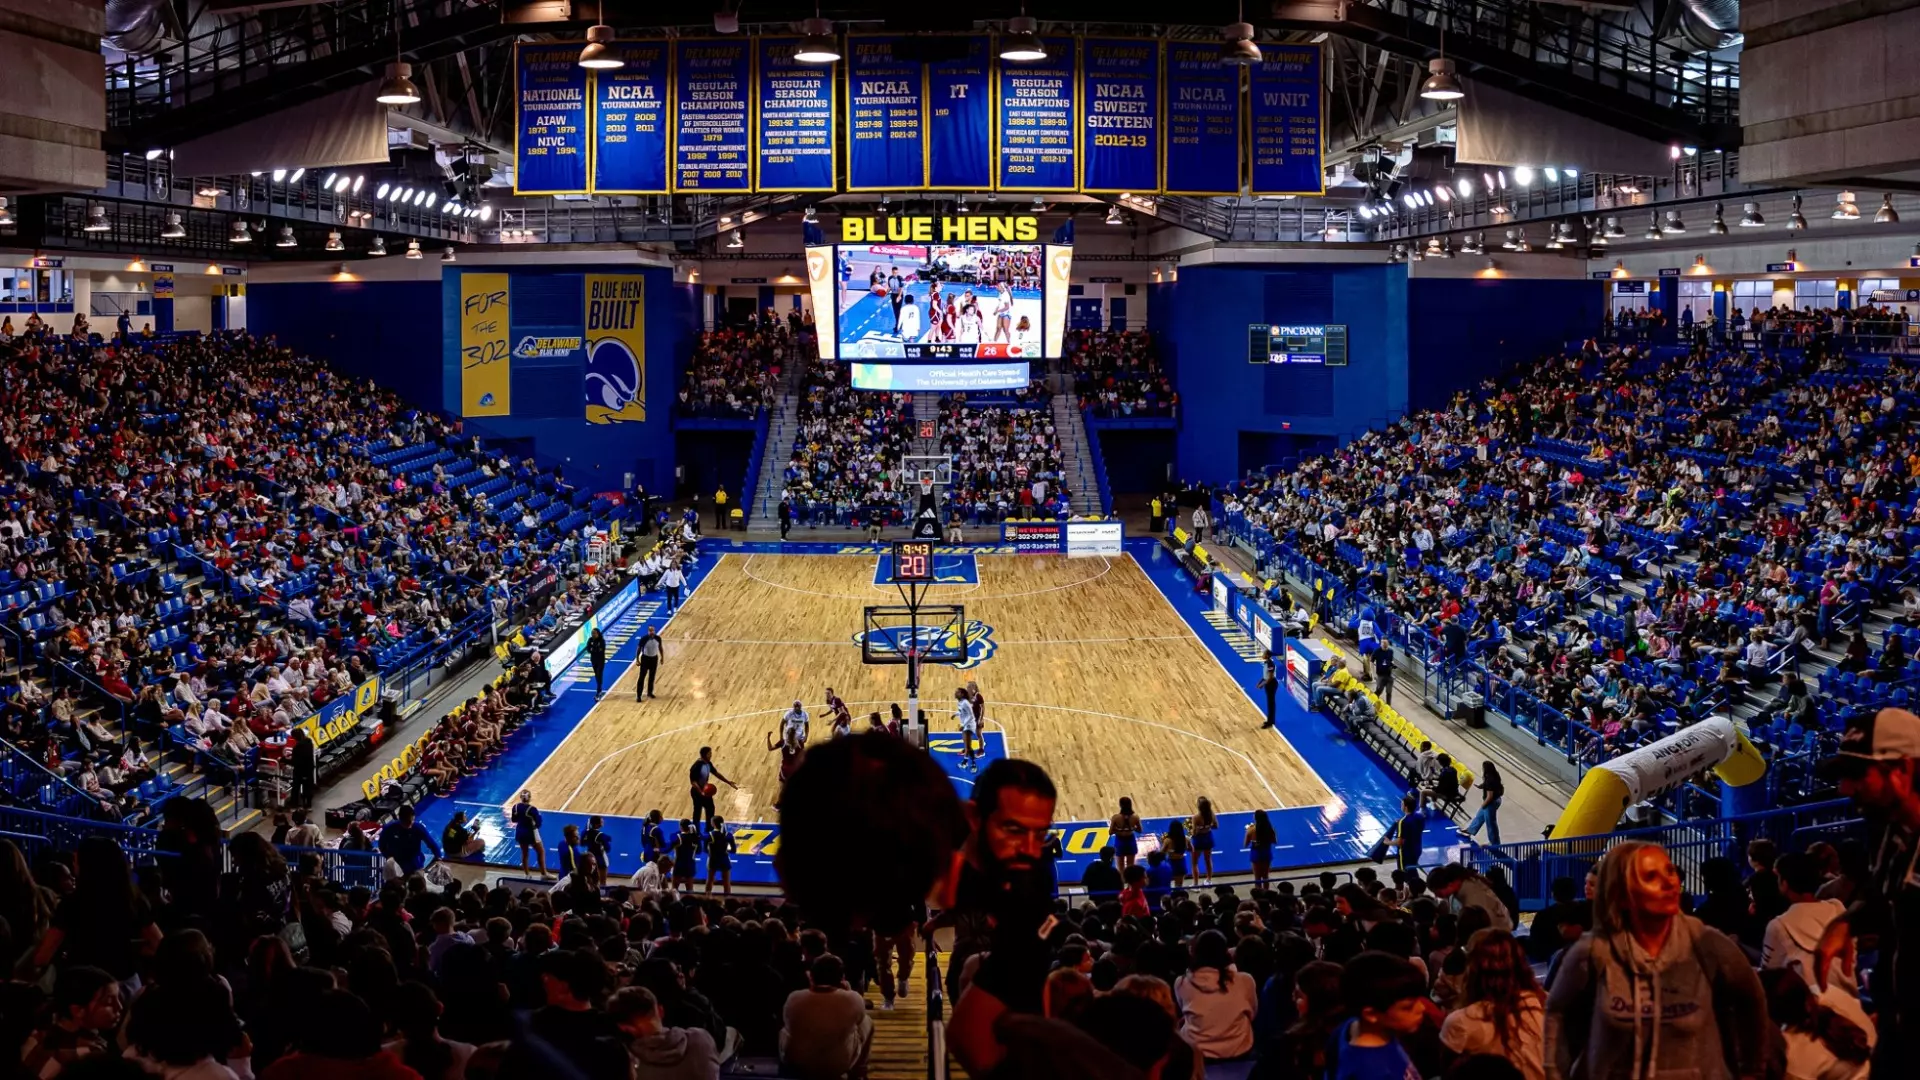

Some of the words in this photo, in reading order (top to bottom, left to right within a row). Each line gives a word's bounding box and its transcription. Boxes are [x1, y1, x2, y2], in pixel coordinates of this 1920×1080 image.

[688, 82, 738, 90] REGULAR
[772, 80, 820, 88] REGULAR
[861, 82, 910, 94] NCAA
[1012, 79, 1062, 88] REGULAR
[523, 88, 581, 101] NATIONAL
[608, 86, 655, 99] NCAA
[692, 92, 734, 100] SEASON
[775, 90, 817, 98] SEASON
[1016, 88, 1058, 97] SEASON
[1096, 84, 1145, 98] NCAA
[1180, 88, 1226, 101] NCAA
[765, 100, 828, 108] CHAMPIONS
[854, 96, 918, 104] TOURNAMENT
[1005, 98, 1070, 107] CHAMPIONS
[1263, 92, 1310, 107] WNIT
[524, 102, 582, 111] TOURNAMENTS
[601, 101, 661, 109] TOURNAMENT
[681, 101, 744, 110] CHAMPIONS
[1094, 100, 1148, 113] SWEET
[1172, 102, 1232, 110] TOURNAMENT
[536, 116, 566, 126] AIAW
[606, 113, 627, 121] 2007
[1088, 116, 1154, 128] SIXTEEN
[538, 137, 565, 147] NIVC
[1094, 134, 1146, 146] 2012-13
[842, 216, 932, 242] BLUE
[942, 216, 1038, 241] HENS
[592, 281, 618, 298] BLUE
[620, 281, 642, 298] HEN
[465, 291, 509, 316] FOR
[588, 300, 640, 330] BUILT
[471, 321, 498, 334] THE
[536, 339, 580, 348] DELAWARE
[462, 340, 510, 369] 302
[555, 348, 570, 356] HENS
[984, 346, 996, 356] 26
[920, 428, 932, 437] 20
[902, 544, 929, 554] 9:43
[901, 556, 925, 576] 20
